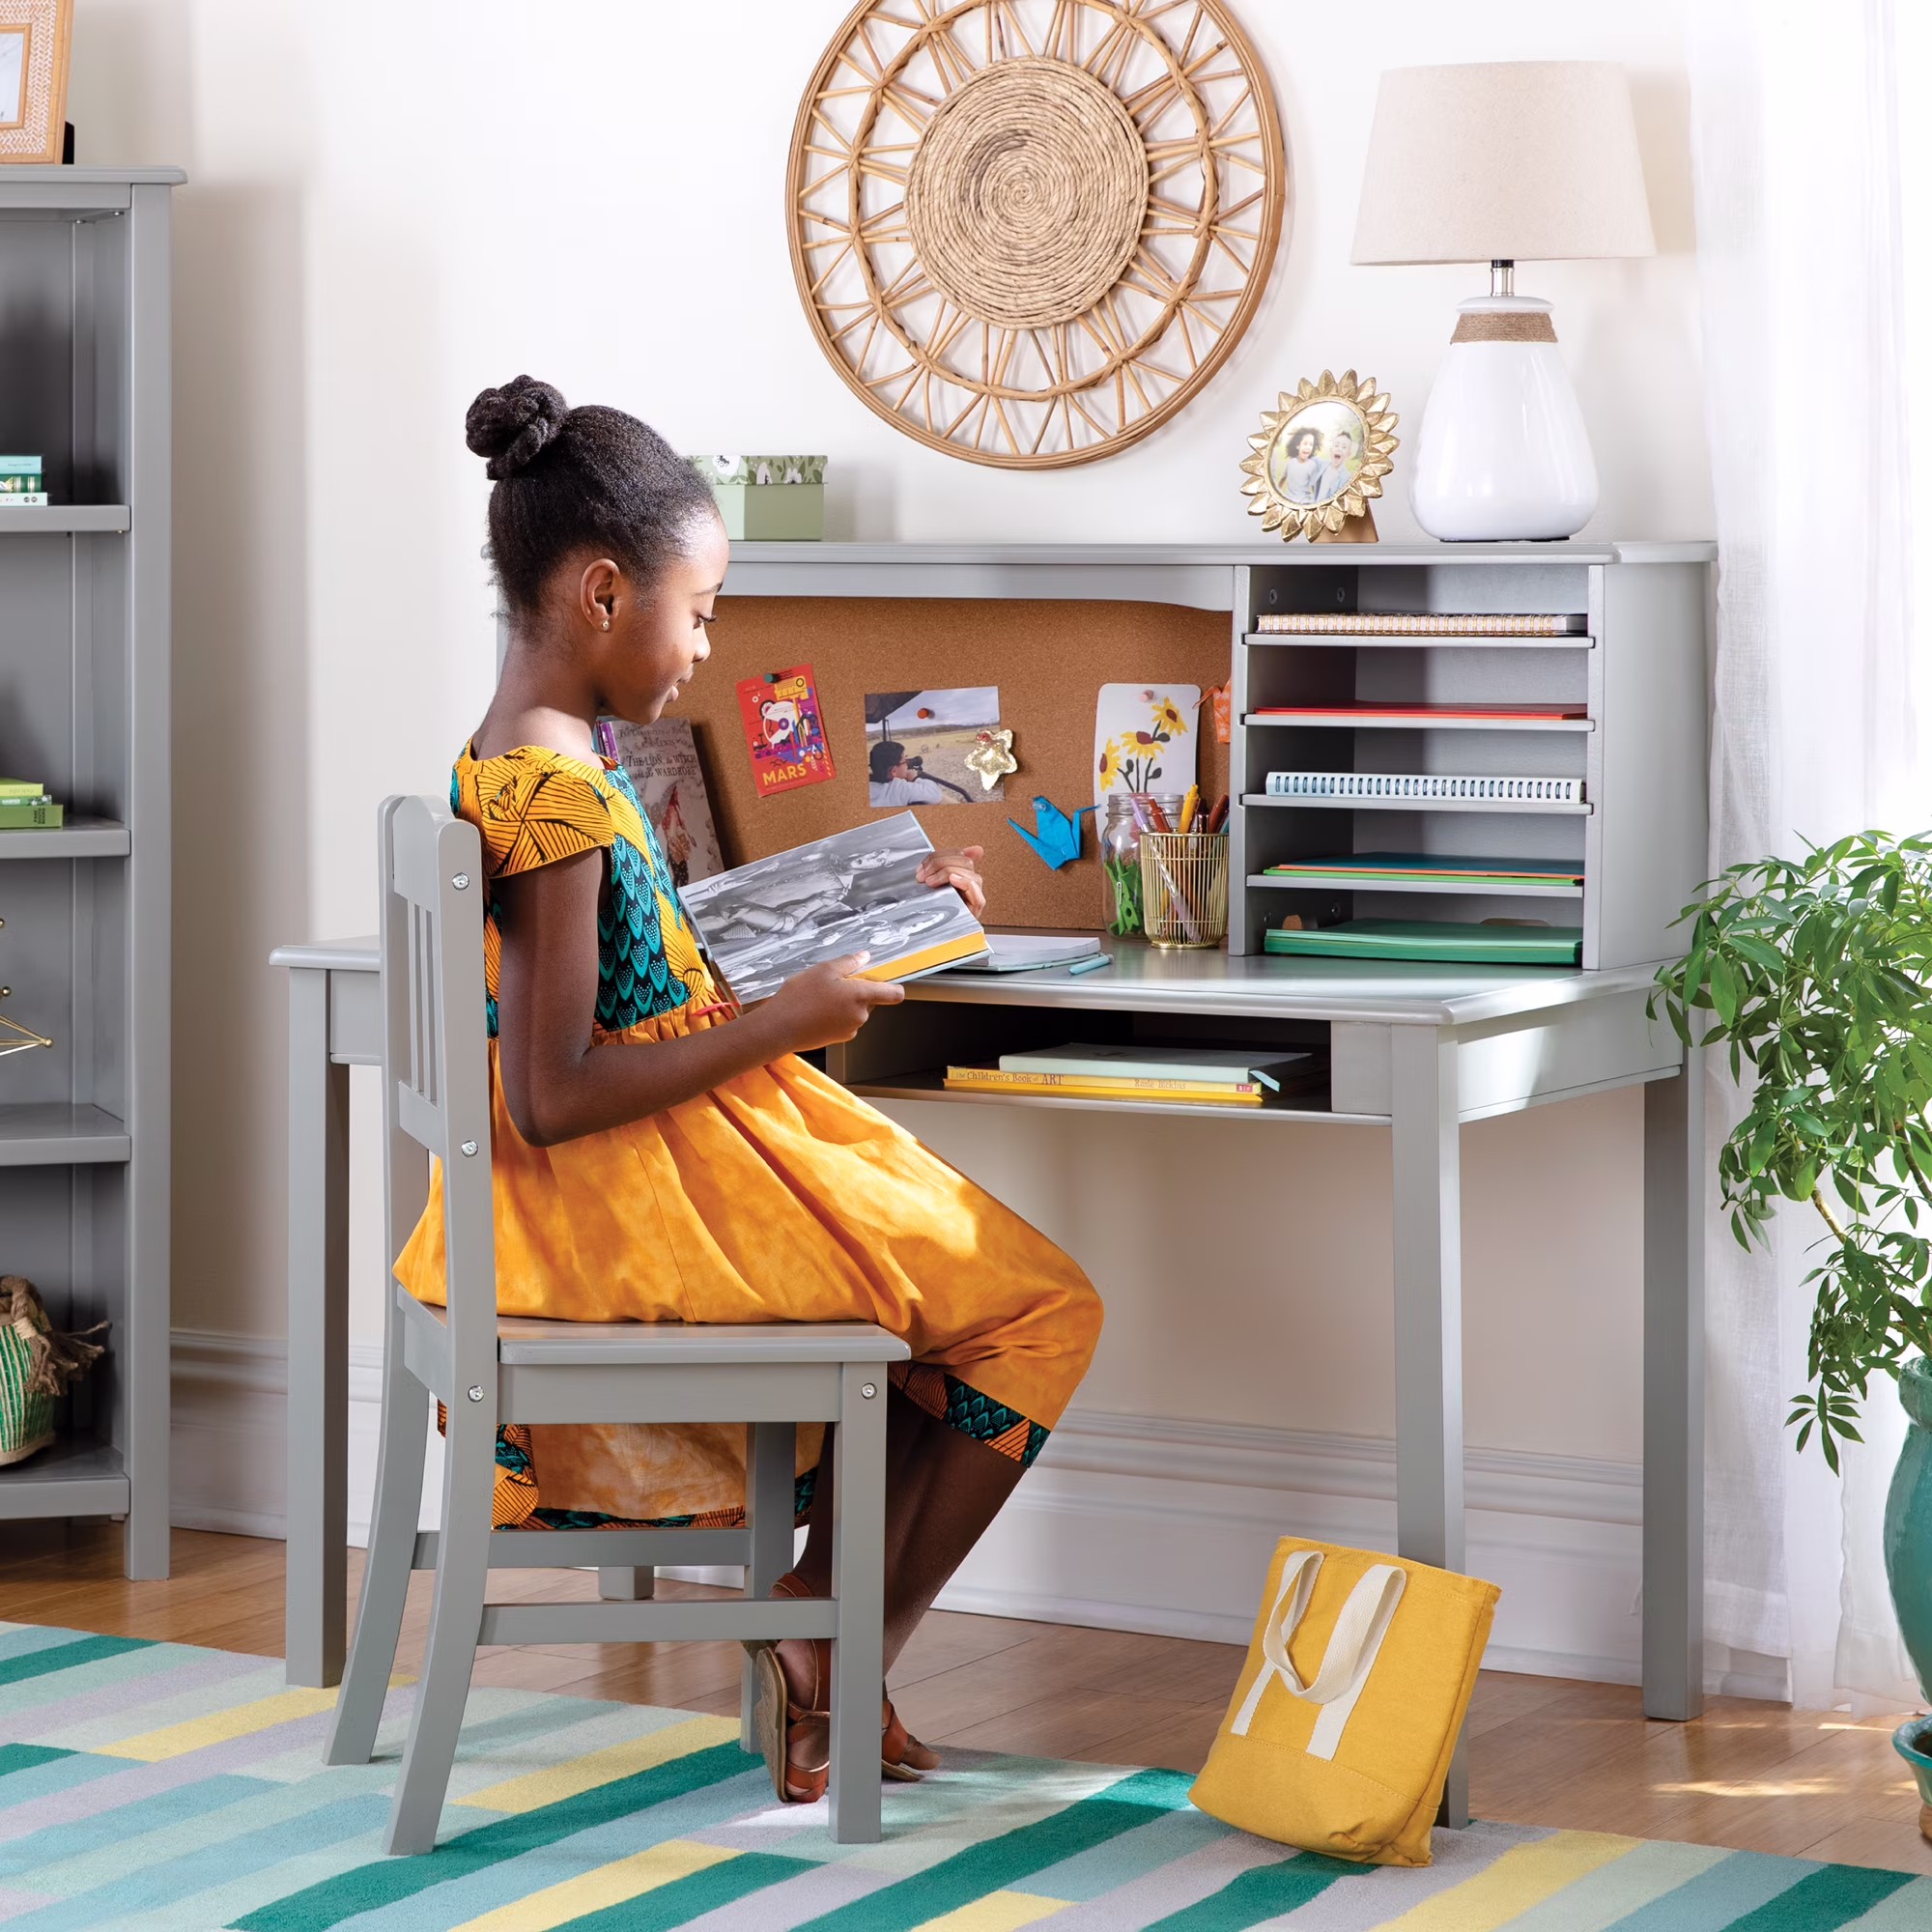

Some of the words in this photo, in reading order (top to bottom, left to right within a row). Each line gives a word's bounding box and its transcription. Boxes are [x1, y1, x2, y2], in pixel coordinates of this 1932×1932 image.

[672, 753, 696, 764] WITCH
[655, 765, 696, 777] WARDROBE
[762, 763, 808, 786] MARS
[967, 1070, 1010, 1082] Children's
[1012, 1072, 1033, 1083] Book
[1041, 1073, 1065, 1086] ART
[1134, 1078, 1155, 1089] Rosie
[1158, 1079, 1186, 1091] Dickins
